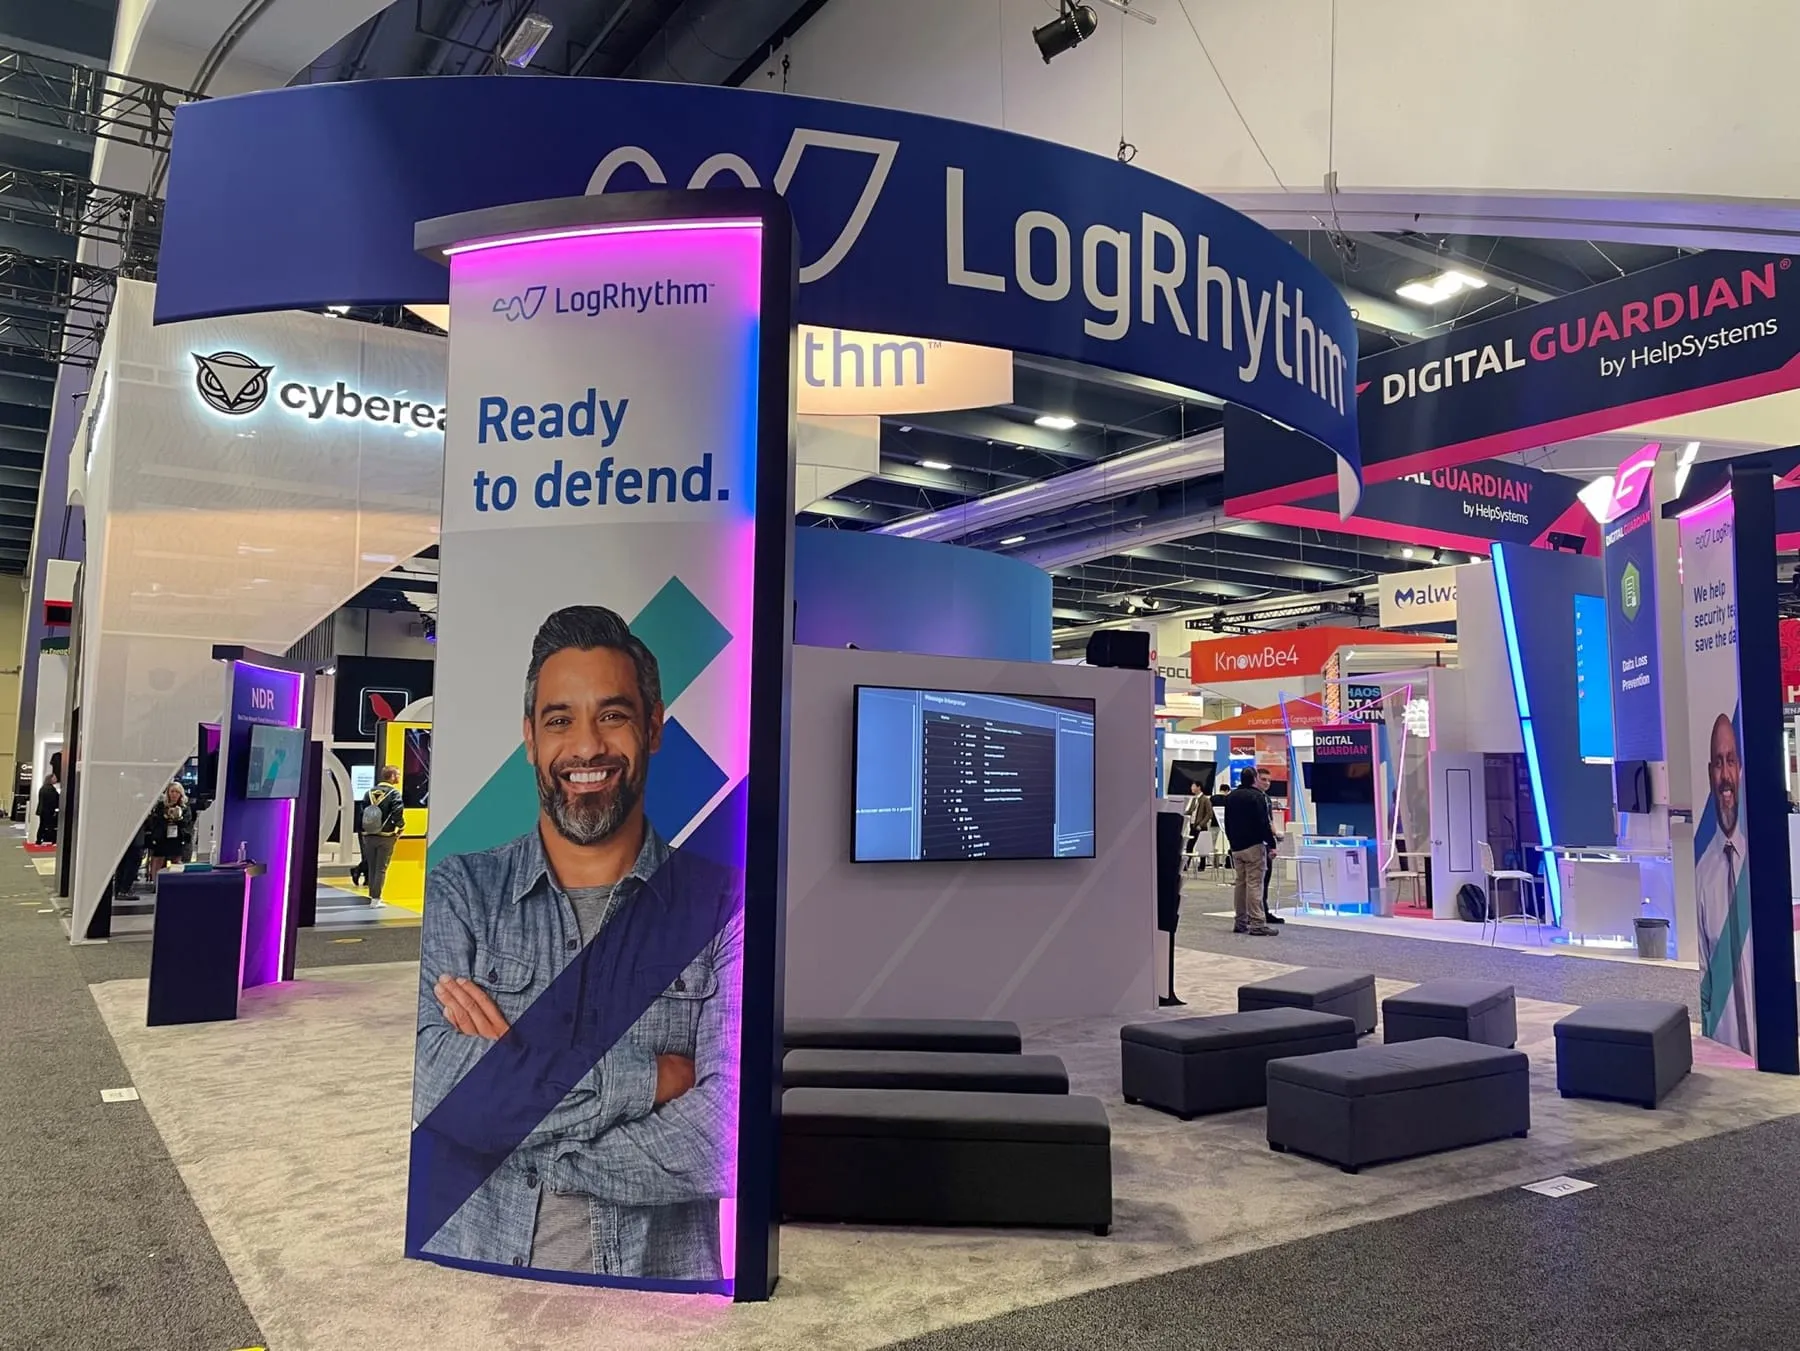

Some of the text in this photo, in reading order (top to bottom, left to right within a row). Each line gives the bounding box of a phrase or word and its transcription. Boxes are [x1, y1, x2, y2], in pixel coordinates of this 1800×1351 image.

[1601, 318, 1778, 377] by HelpSystems
[1382, 338, 1526, 406] DIGITAL
[478, 388, 629, 448] Ready
[473, 453, 730, 512] to defend.
[1463, 501, 1529, 525] by HelpSystems
[1693, 580, 1726, 603] We help
[1694, 605, 1726, 628] security
[1695, 637, 1713, 652] save
[1715, 630, 1727, 646] the
[1215, 645, 1299, 672] KnowBe4
[251, 687, 275, 711] NDR
[1351, 710, 1385, 720] UTIN
[1315, 735, 1354, 746] DIGITAL
